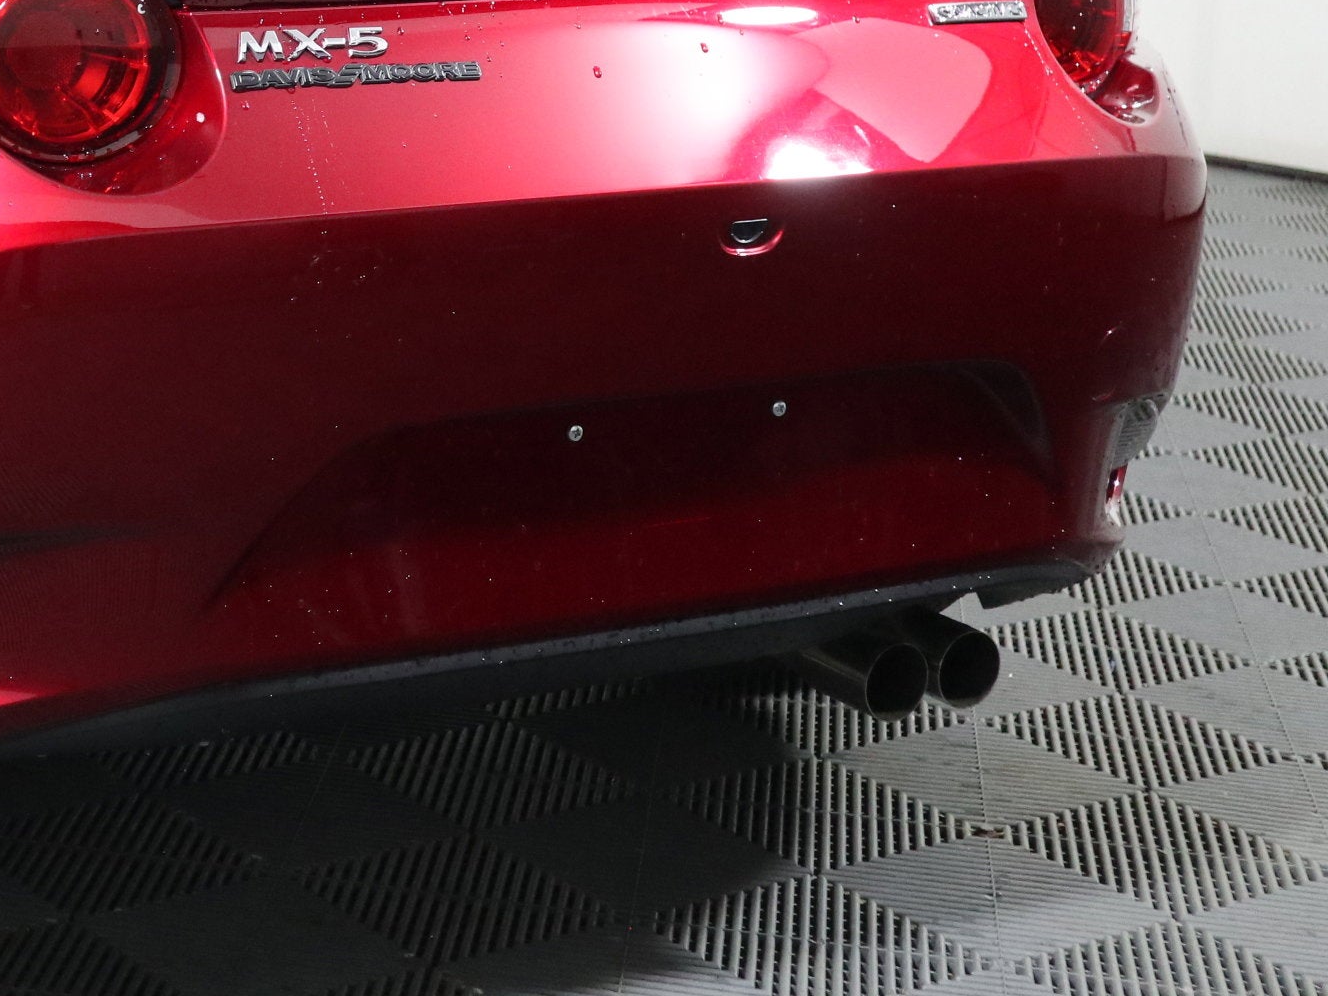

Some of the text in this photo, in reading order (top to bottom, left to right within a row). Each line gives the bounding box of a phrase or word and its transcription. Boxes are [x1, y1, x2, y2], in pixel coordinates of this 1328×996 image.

[237, 26, 388, 63] MX-5
[230, 62, 481, 92] DAVIS MOORE
